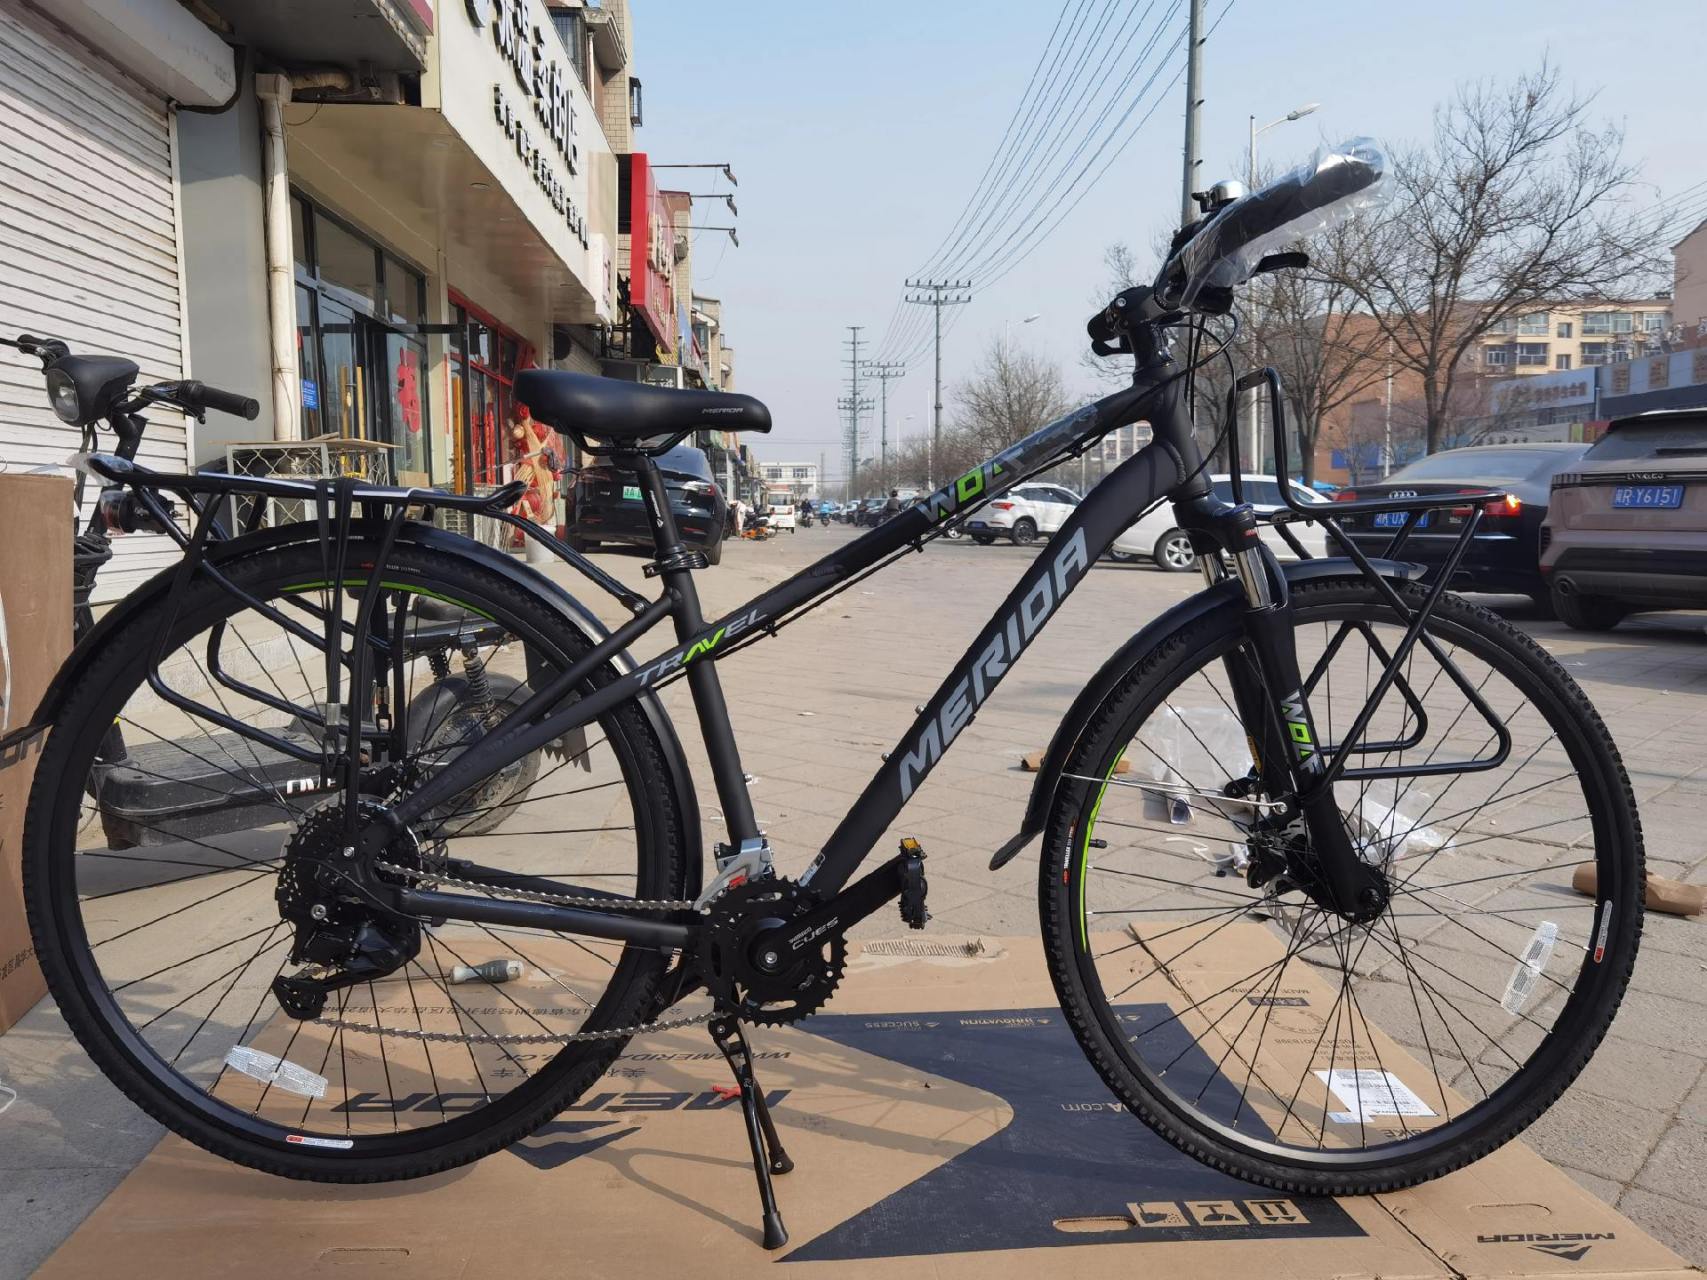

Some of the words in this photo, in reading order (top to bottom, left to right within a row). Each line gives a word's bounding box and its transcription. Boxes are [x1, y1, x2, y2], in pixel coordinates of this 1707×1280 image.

[635, 608, 769, 688] TRAVEL
[899, 527, 1088, 803] MERIDA
[792, 916, 839, 950] CUES
[1477, 1232, 1616, 1243] MERIDA
